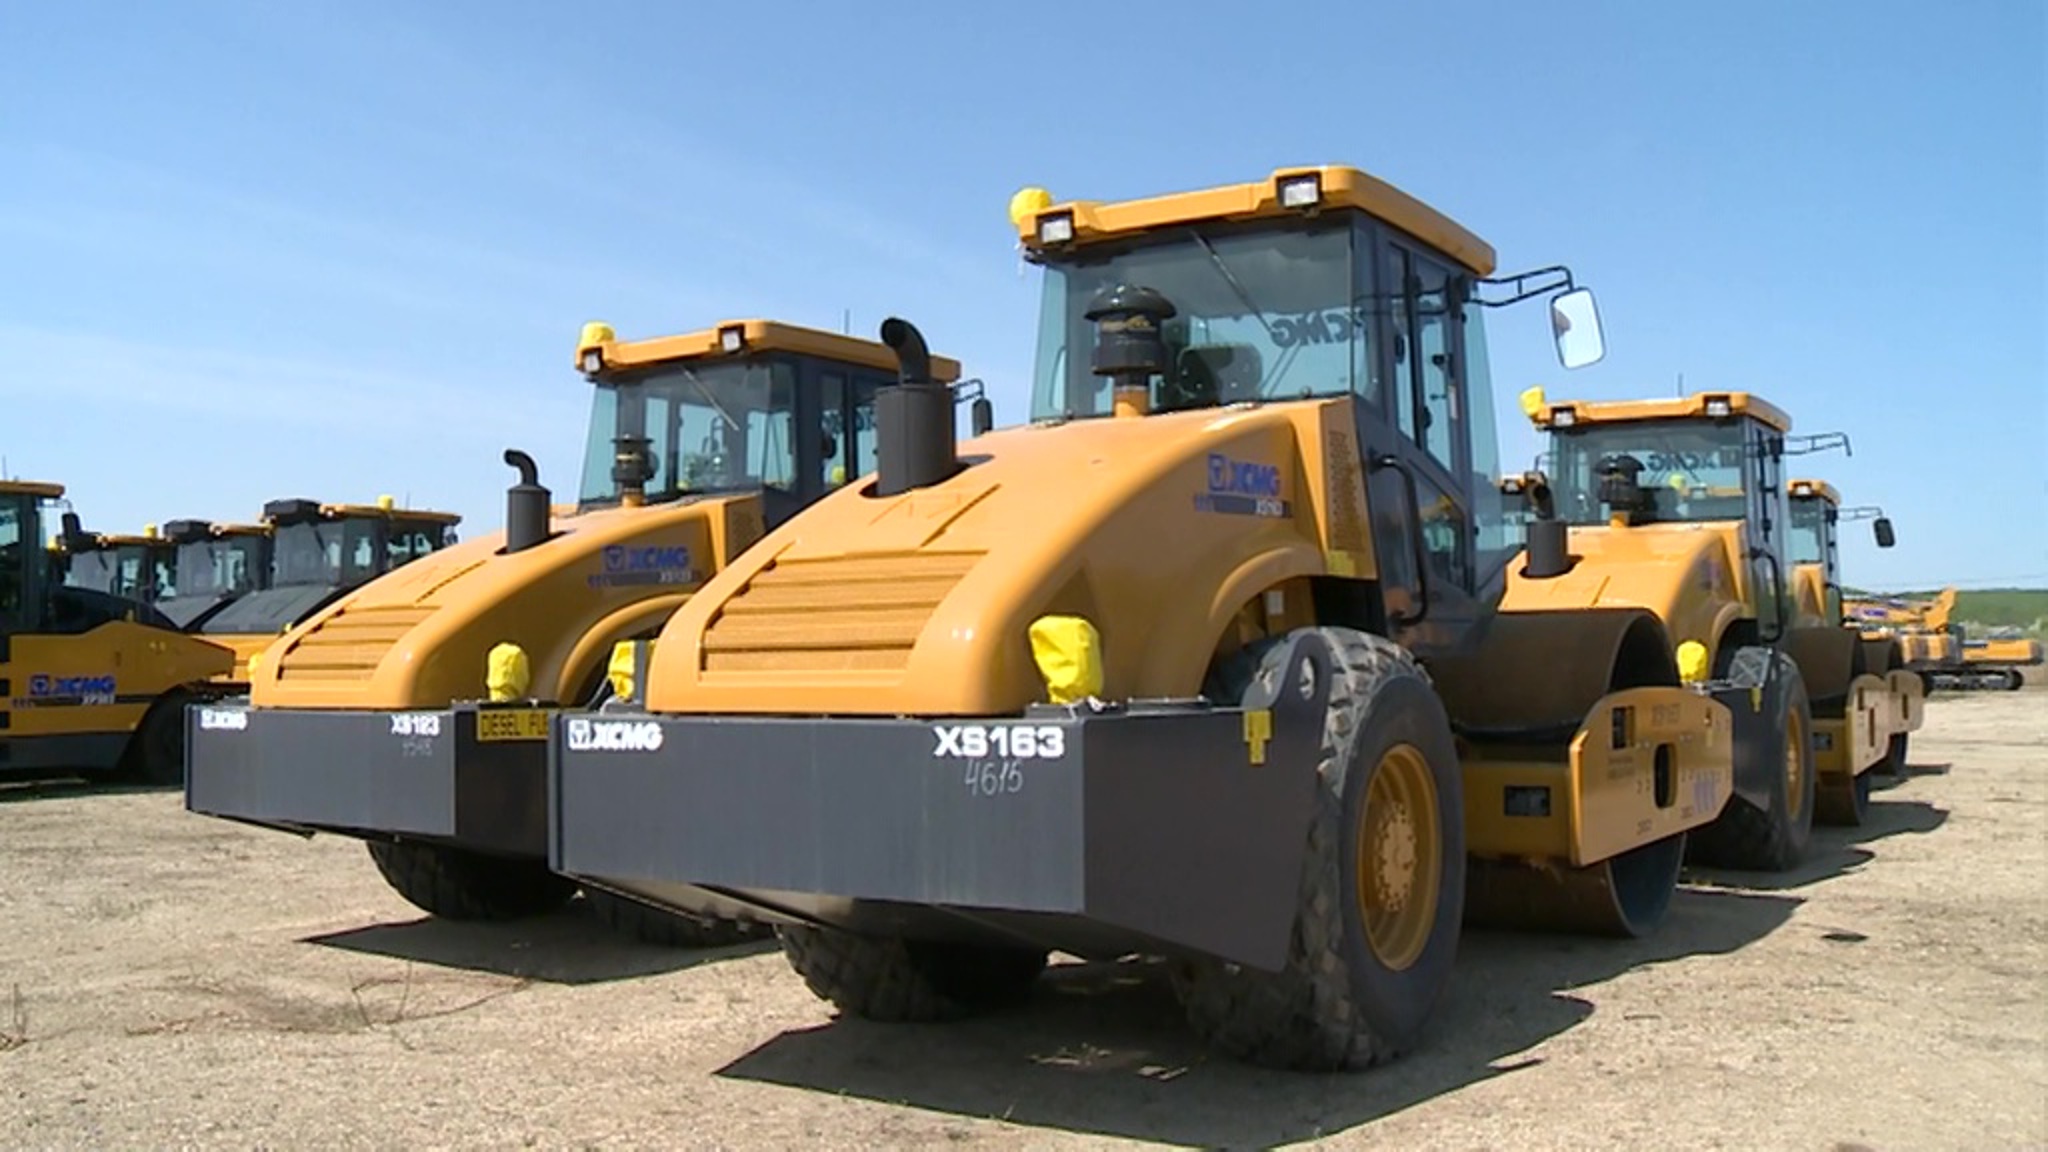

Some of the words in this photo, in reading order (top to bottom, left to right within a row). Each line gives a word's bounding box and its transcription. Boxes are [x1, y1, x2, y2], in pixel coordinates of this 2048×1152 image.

[1230, 461, 1281, 497] XCMG
[627, 546, 689, 570] XCMG
[481, 713, 522, 736] DIESEL
[590, 721, 663, 750] XCMG
[933, 725, 1065, 758] XS163
